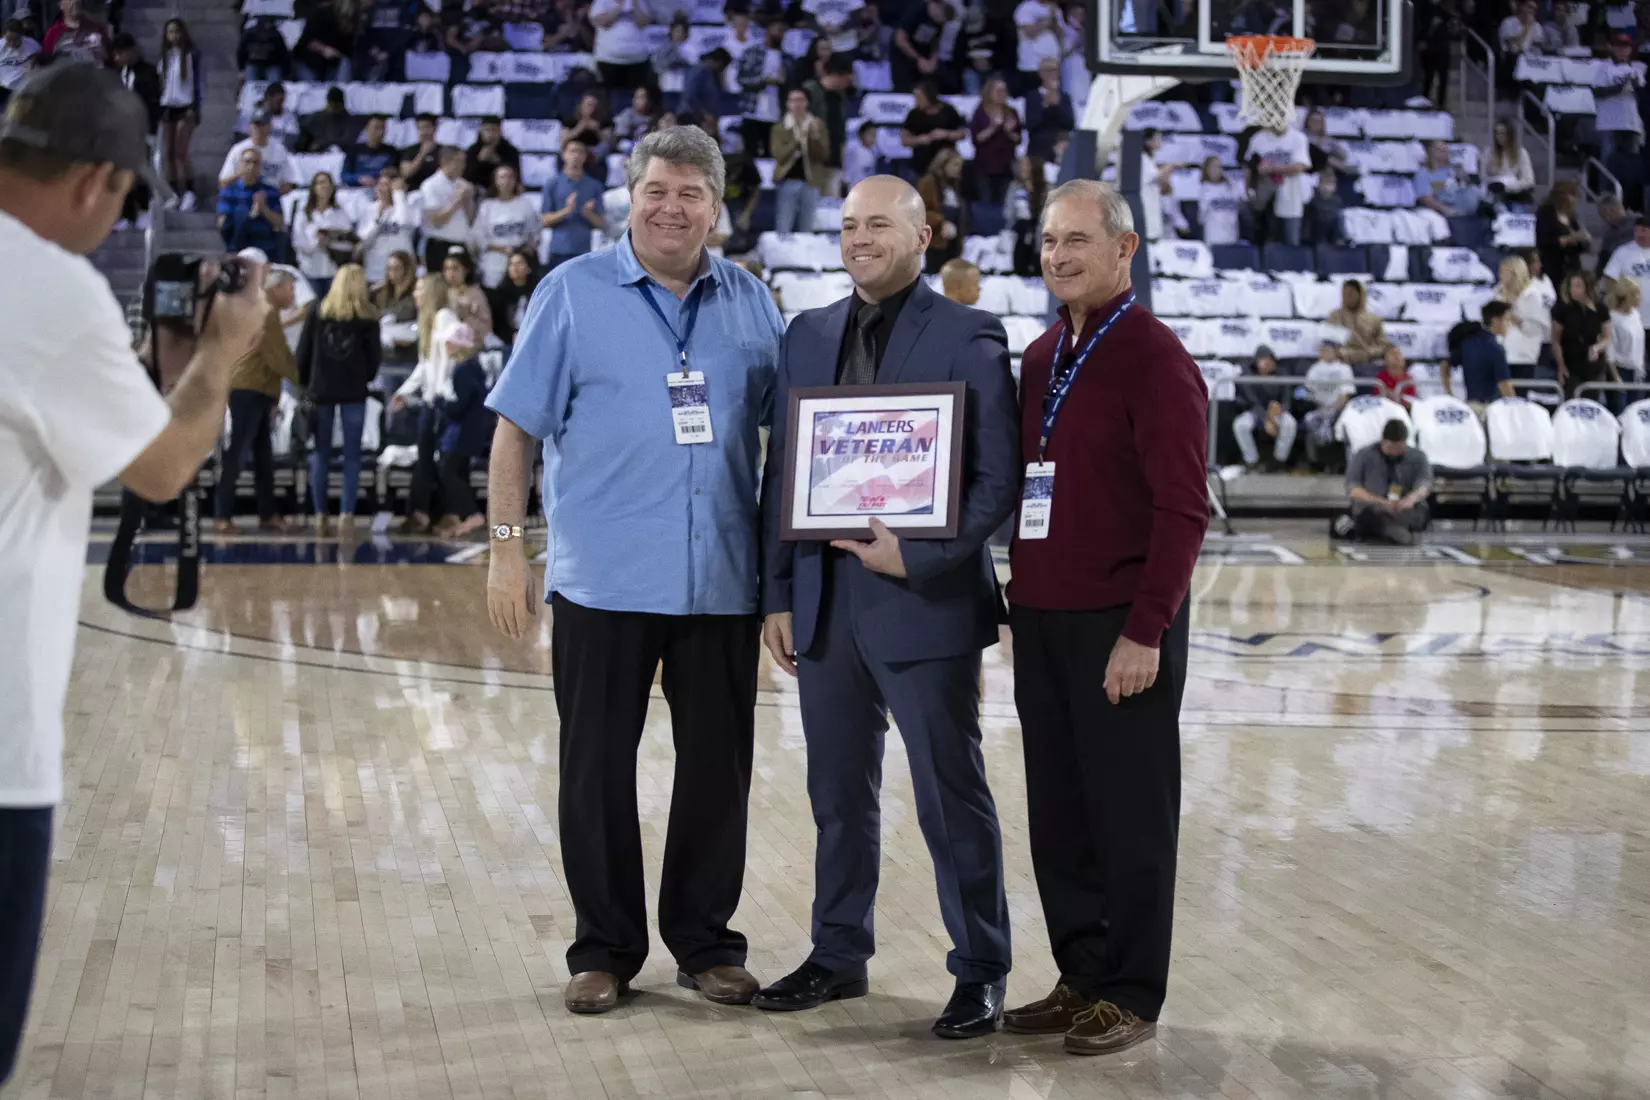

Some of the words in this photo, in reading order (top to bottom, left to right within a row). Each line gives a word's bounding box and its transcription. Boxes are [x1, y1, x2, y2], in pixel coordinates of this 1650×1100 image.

[845, 419, 915, 435] LANCERS
[820, 437, 934, 455] VETERAN
[863, 453, 887, 464] THE
[892, 453, 929, 463] GAME
